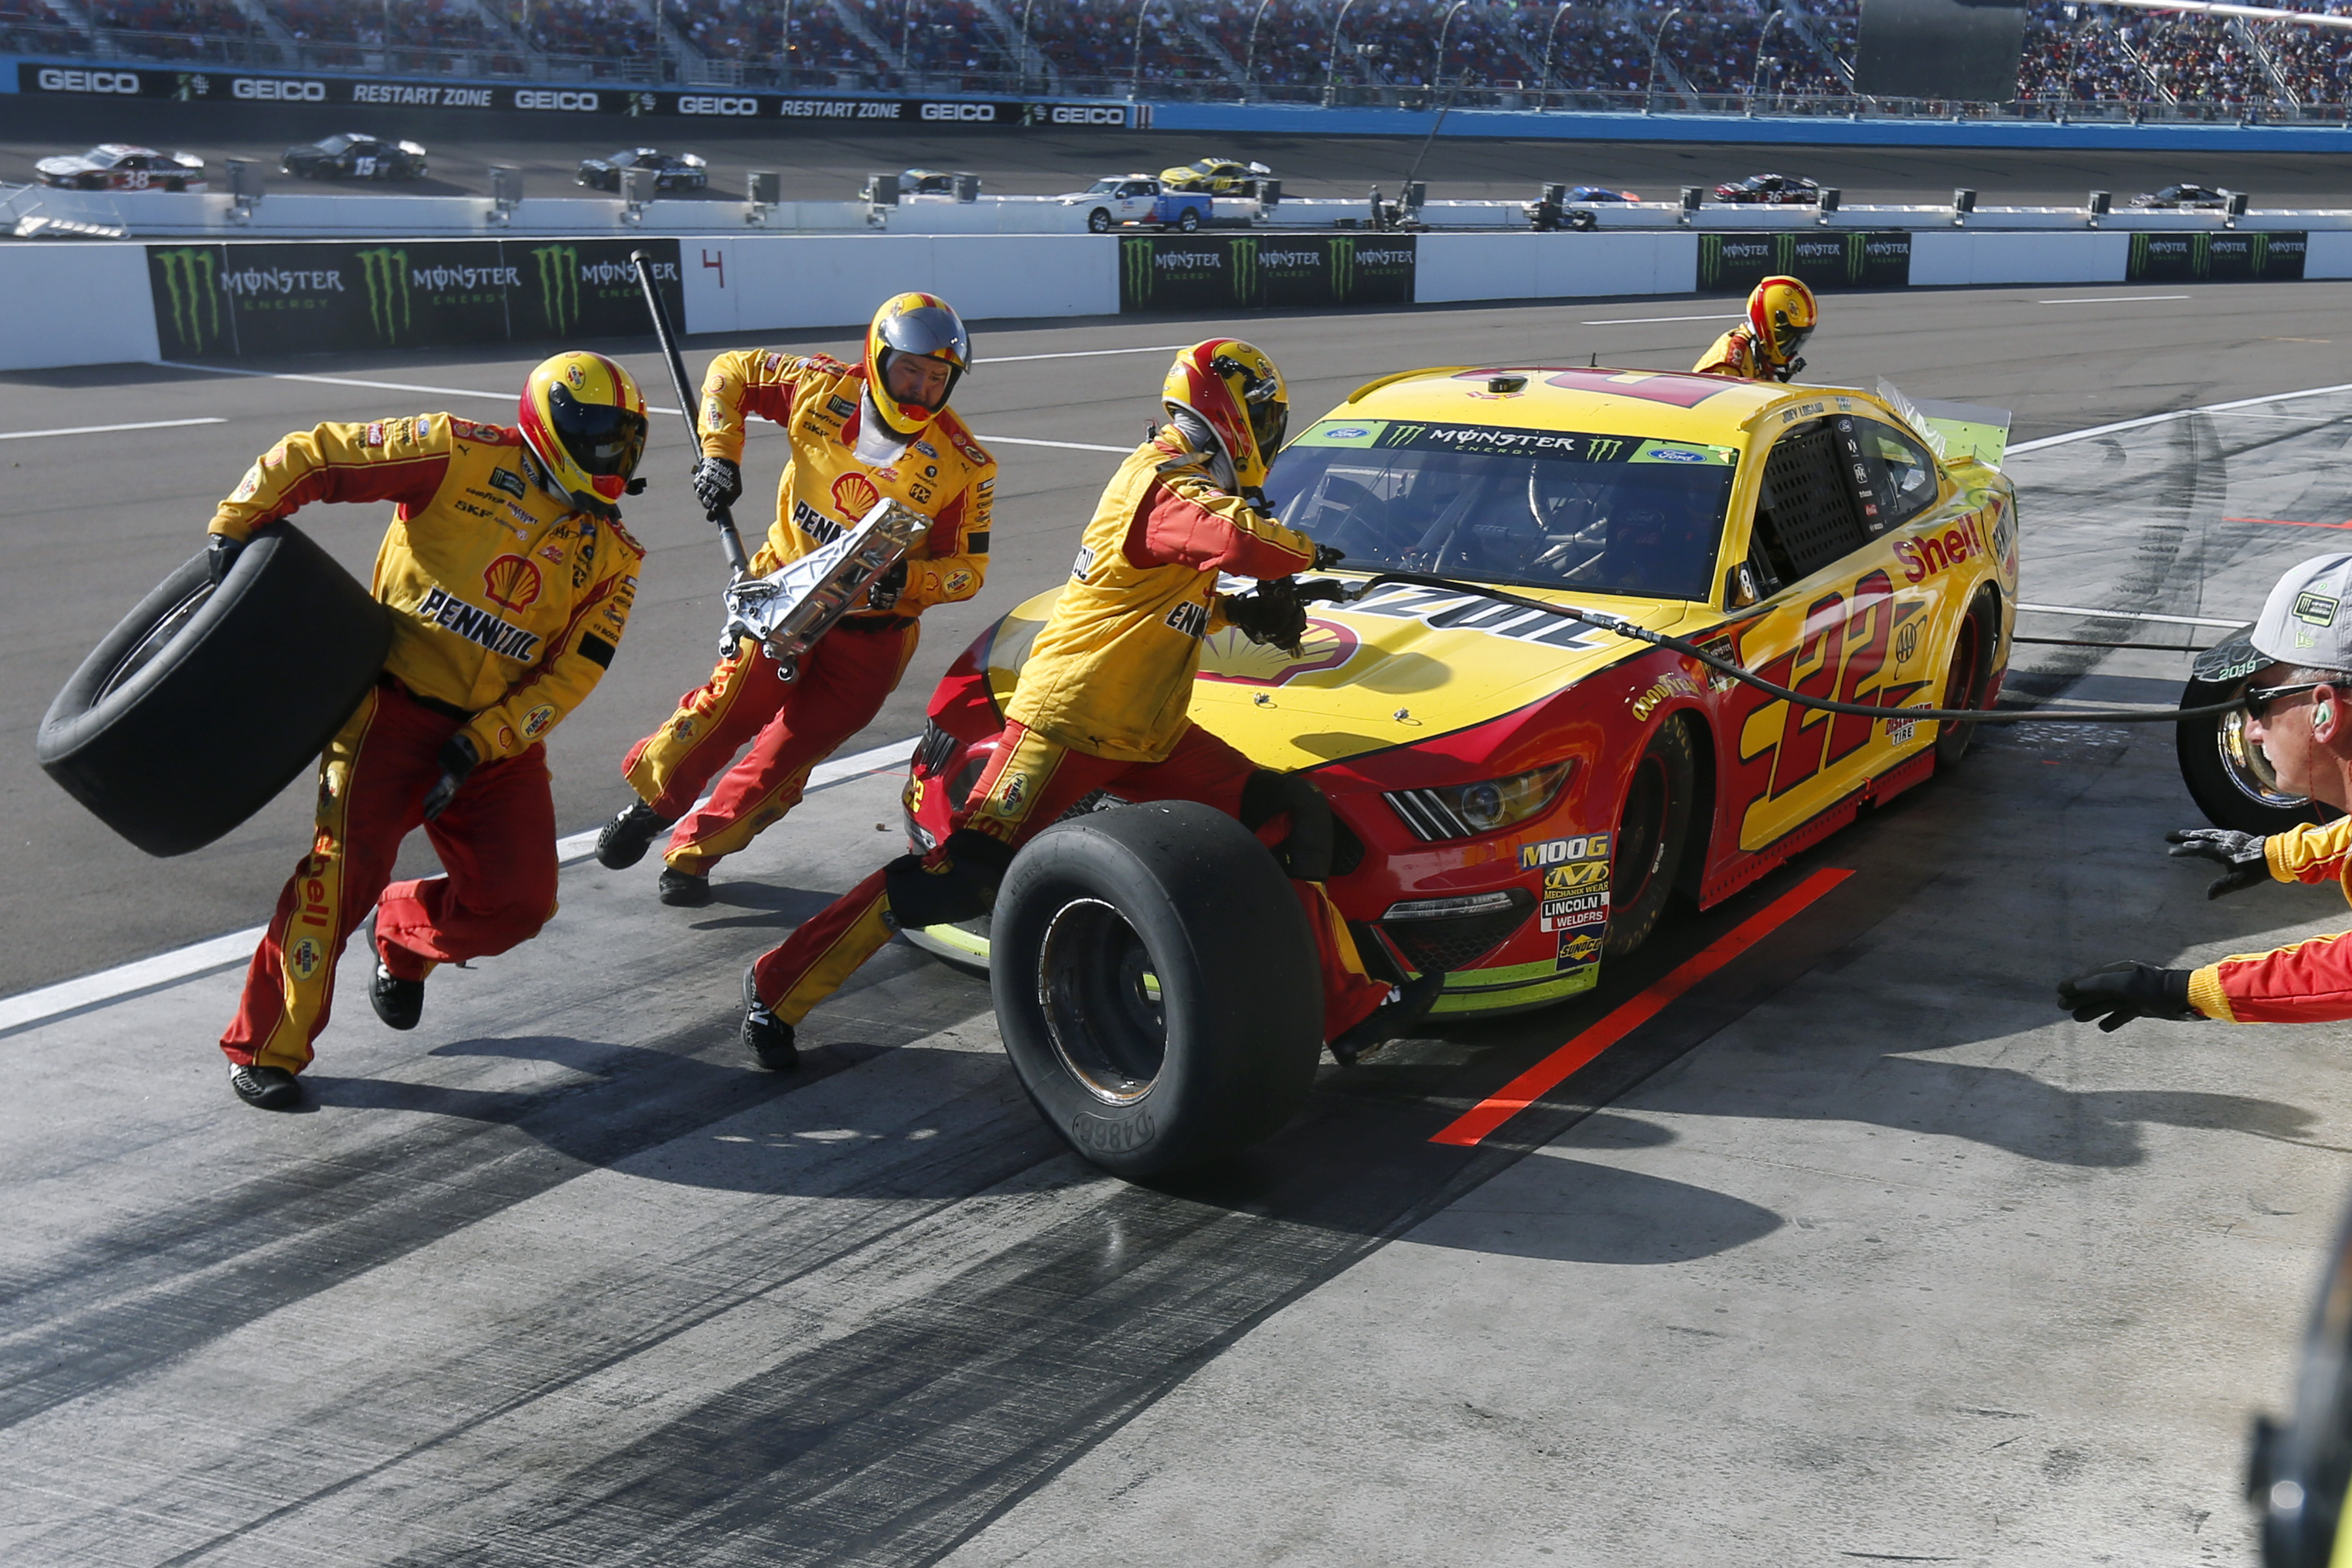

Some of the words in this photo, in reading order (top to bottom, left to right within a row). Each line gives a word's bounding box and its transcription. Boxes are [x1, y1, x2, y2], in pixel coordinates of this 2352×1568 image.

[39, 69, 139, 93] GEICO
[233, 79, 325, 101] GEICO
[353, 84, 442, 104] RESTART
[442, 89, 491, 107] ZONE
[515, 90, 598, 111] GEICO
[679, 96, 758, 116] GEICO
[781, 101, 855, 118] RESTART
[857, 103, 901, 118] ZONE
[921, 103, 994, 121] GEICO
[1053, 106, 1124, 124] GEICO
[355, 157, 377, 176] 15
[122, 172, 150, 189] 38
[1765, 191, 1783, 203] 36
[1722, 242, 1769, 258] MONSTER
[1796, 241, 1840, 257] MONSTER
[1866, 241, 1909, 255] MONSTER
[2149, 240, 2187, 253] MONSTER
[2211, 240, 2247, 253] MONSTER
[2268, 240, 2305, 253] MONSTER
[1155, 251, 1221, 270] MONSTER
[1258, 250, 1320, 269] MONSTER
[1356, 248, 1413, 267] MONSTER
[413, 265, 521, 291] MONSTER
[581, 261, 678, 286] MONSER
[702, 249, 725, 288] 4
[221, 267, 344, 294] MONSTER
[433, 294, 507, 305] ENERGY
[599, 289, 664, 298] ENERY
[244, 299, 328, 310] ENERGY
[1782, 408, 1798, 423] JOEY
[802, 421, 829, 437] SKF
[1330, 428, 1364, 438] Ford
[916, 442, 935, 455] Ford
[1429, 428, 1575, 451] MONSTER
[1455, 445, 1537, 455] ENERGY
[1658, 451, 1696, 462] Ford
[521, 454, 540, 489] ENNZOIL
[910, 485, 930, 502] PPG
[454, 499, 493, 518] SKF
[1892, 513, 1984, 583] Shell
[947, 573, 970, 590] PENNZOIL
[1897, 624, 1917, 662] AAA
[2218, 660, 2257, 680] 2019
[696, 657, 743, 719] hell
[1740, 568, 1893, 804] 22
[1632, 674, 1702, 722] GOODYEAR
[525, 708, 552, 736] PENNZOIL
[1894, 726, 1913, 744] TIRE
[1004, 777, 1024, 811] PENNZOIL
[1524, 836, 1608, 868] MOOG
[302, 825, 335, 927] Shell
[1544, 888, 1584, 900] MECHANIX
[1585, 881, 1609, 893] WEAR
[1544, 896, 1598, 916] LINCOLN
[1557, 911, 1603, 927] WELDERS
[302, 940, 312, 973] PENNZOIL
[1560, 938, 1602, 956] SUNOCO
